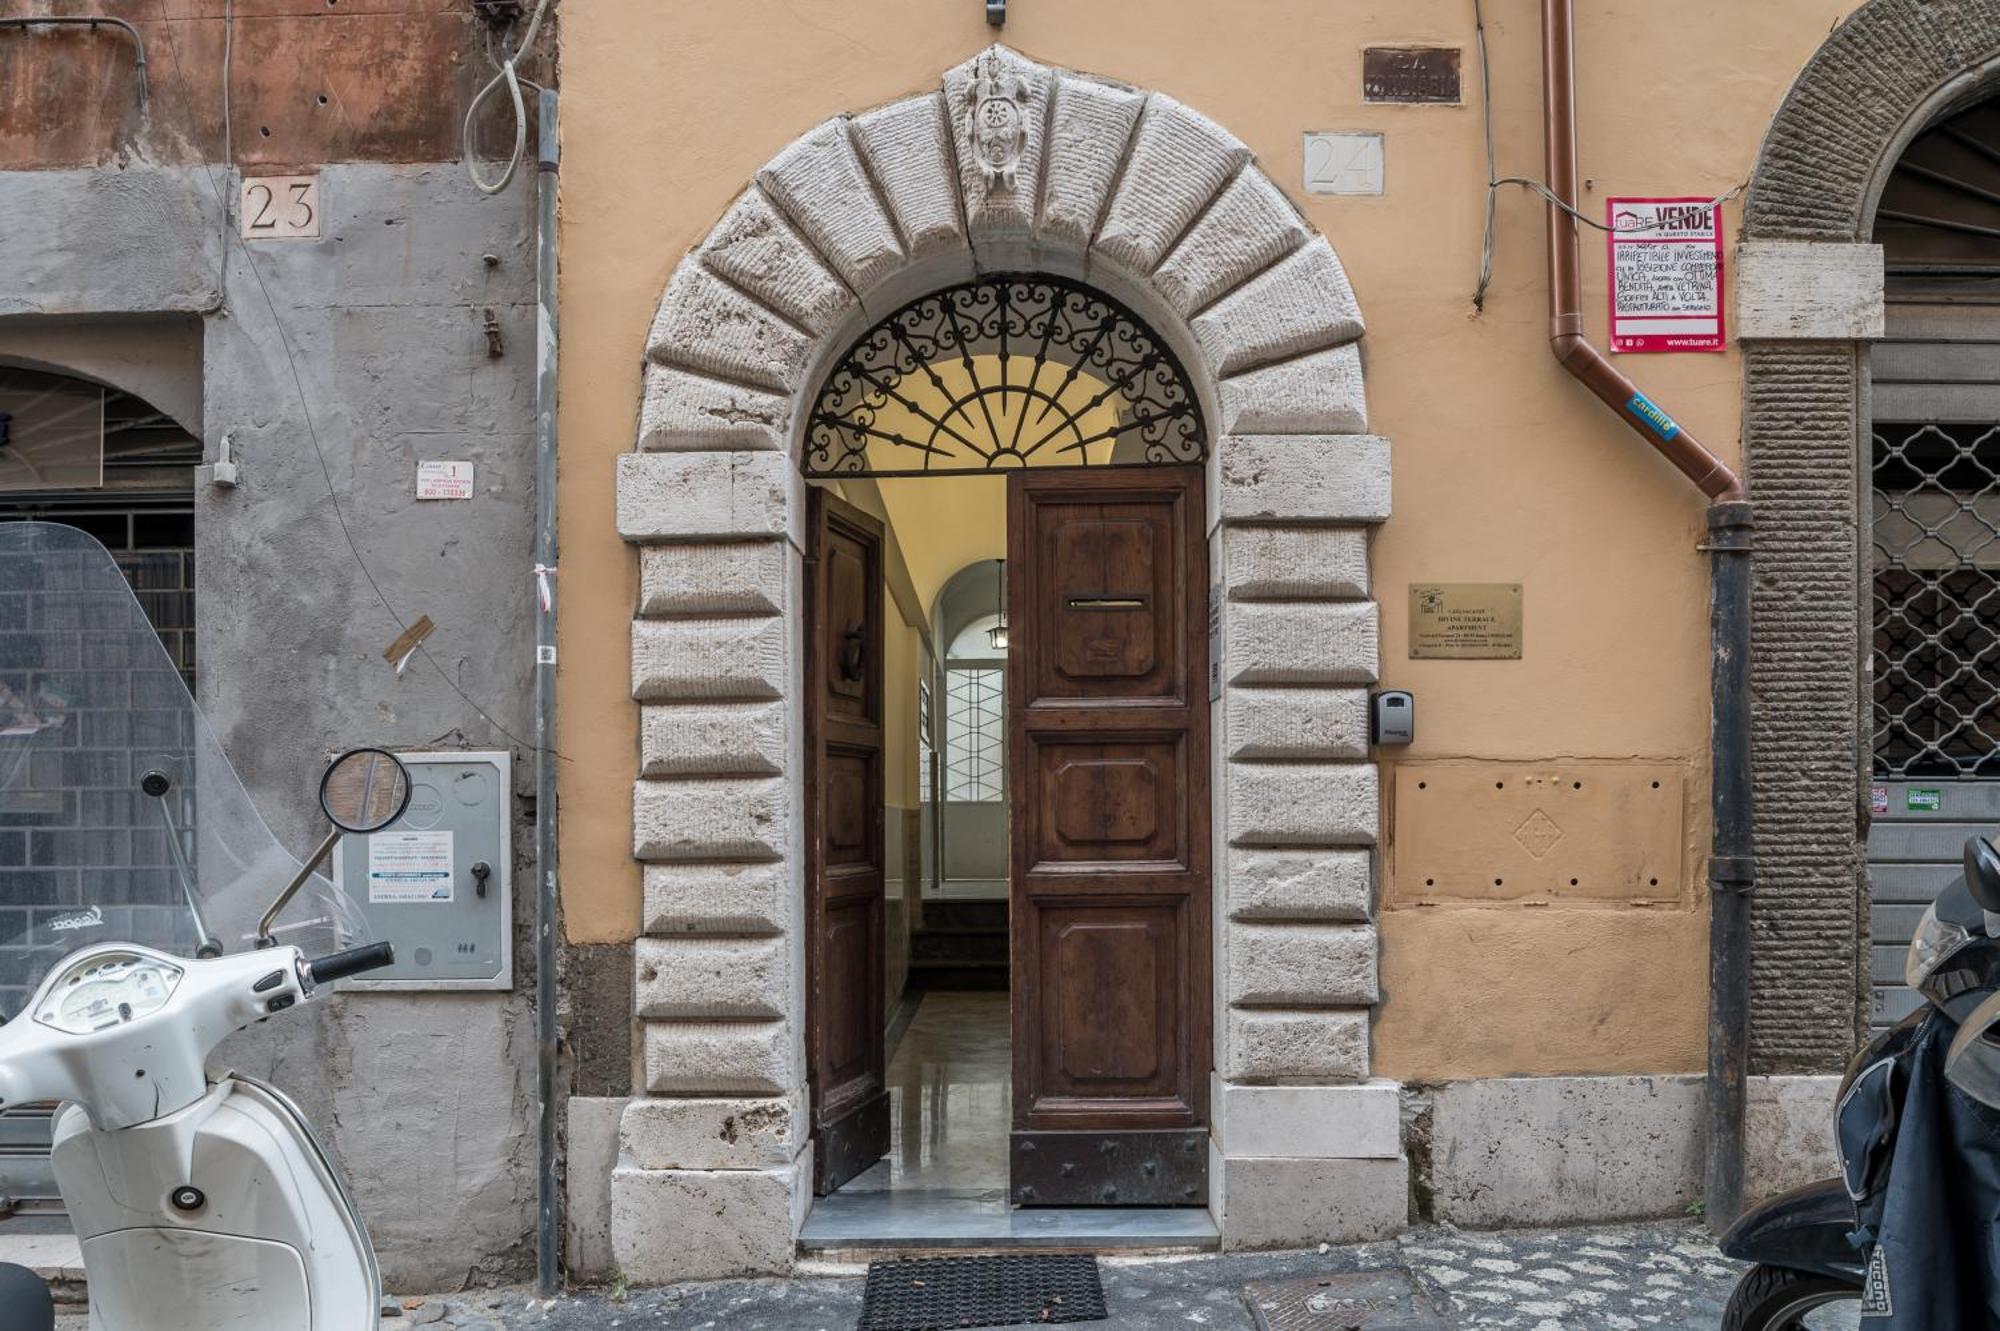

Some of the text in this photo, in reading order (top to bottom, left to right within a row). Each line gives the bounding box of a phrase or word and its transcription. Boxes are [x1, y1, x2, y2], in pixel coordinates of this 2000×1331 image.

[1310, 138, 1376, 186] 24
[246, 184, 313, 230] 23
[1656, 206, 1713, 231] VENDE
[1666, 338, 1719, 347] www.tuare.it
